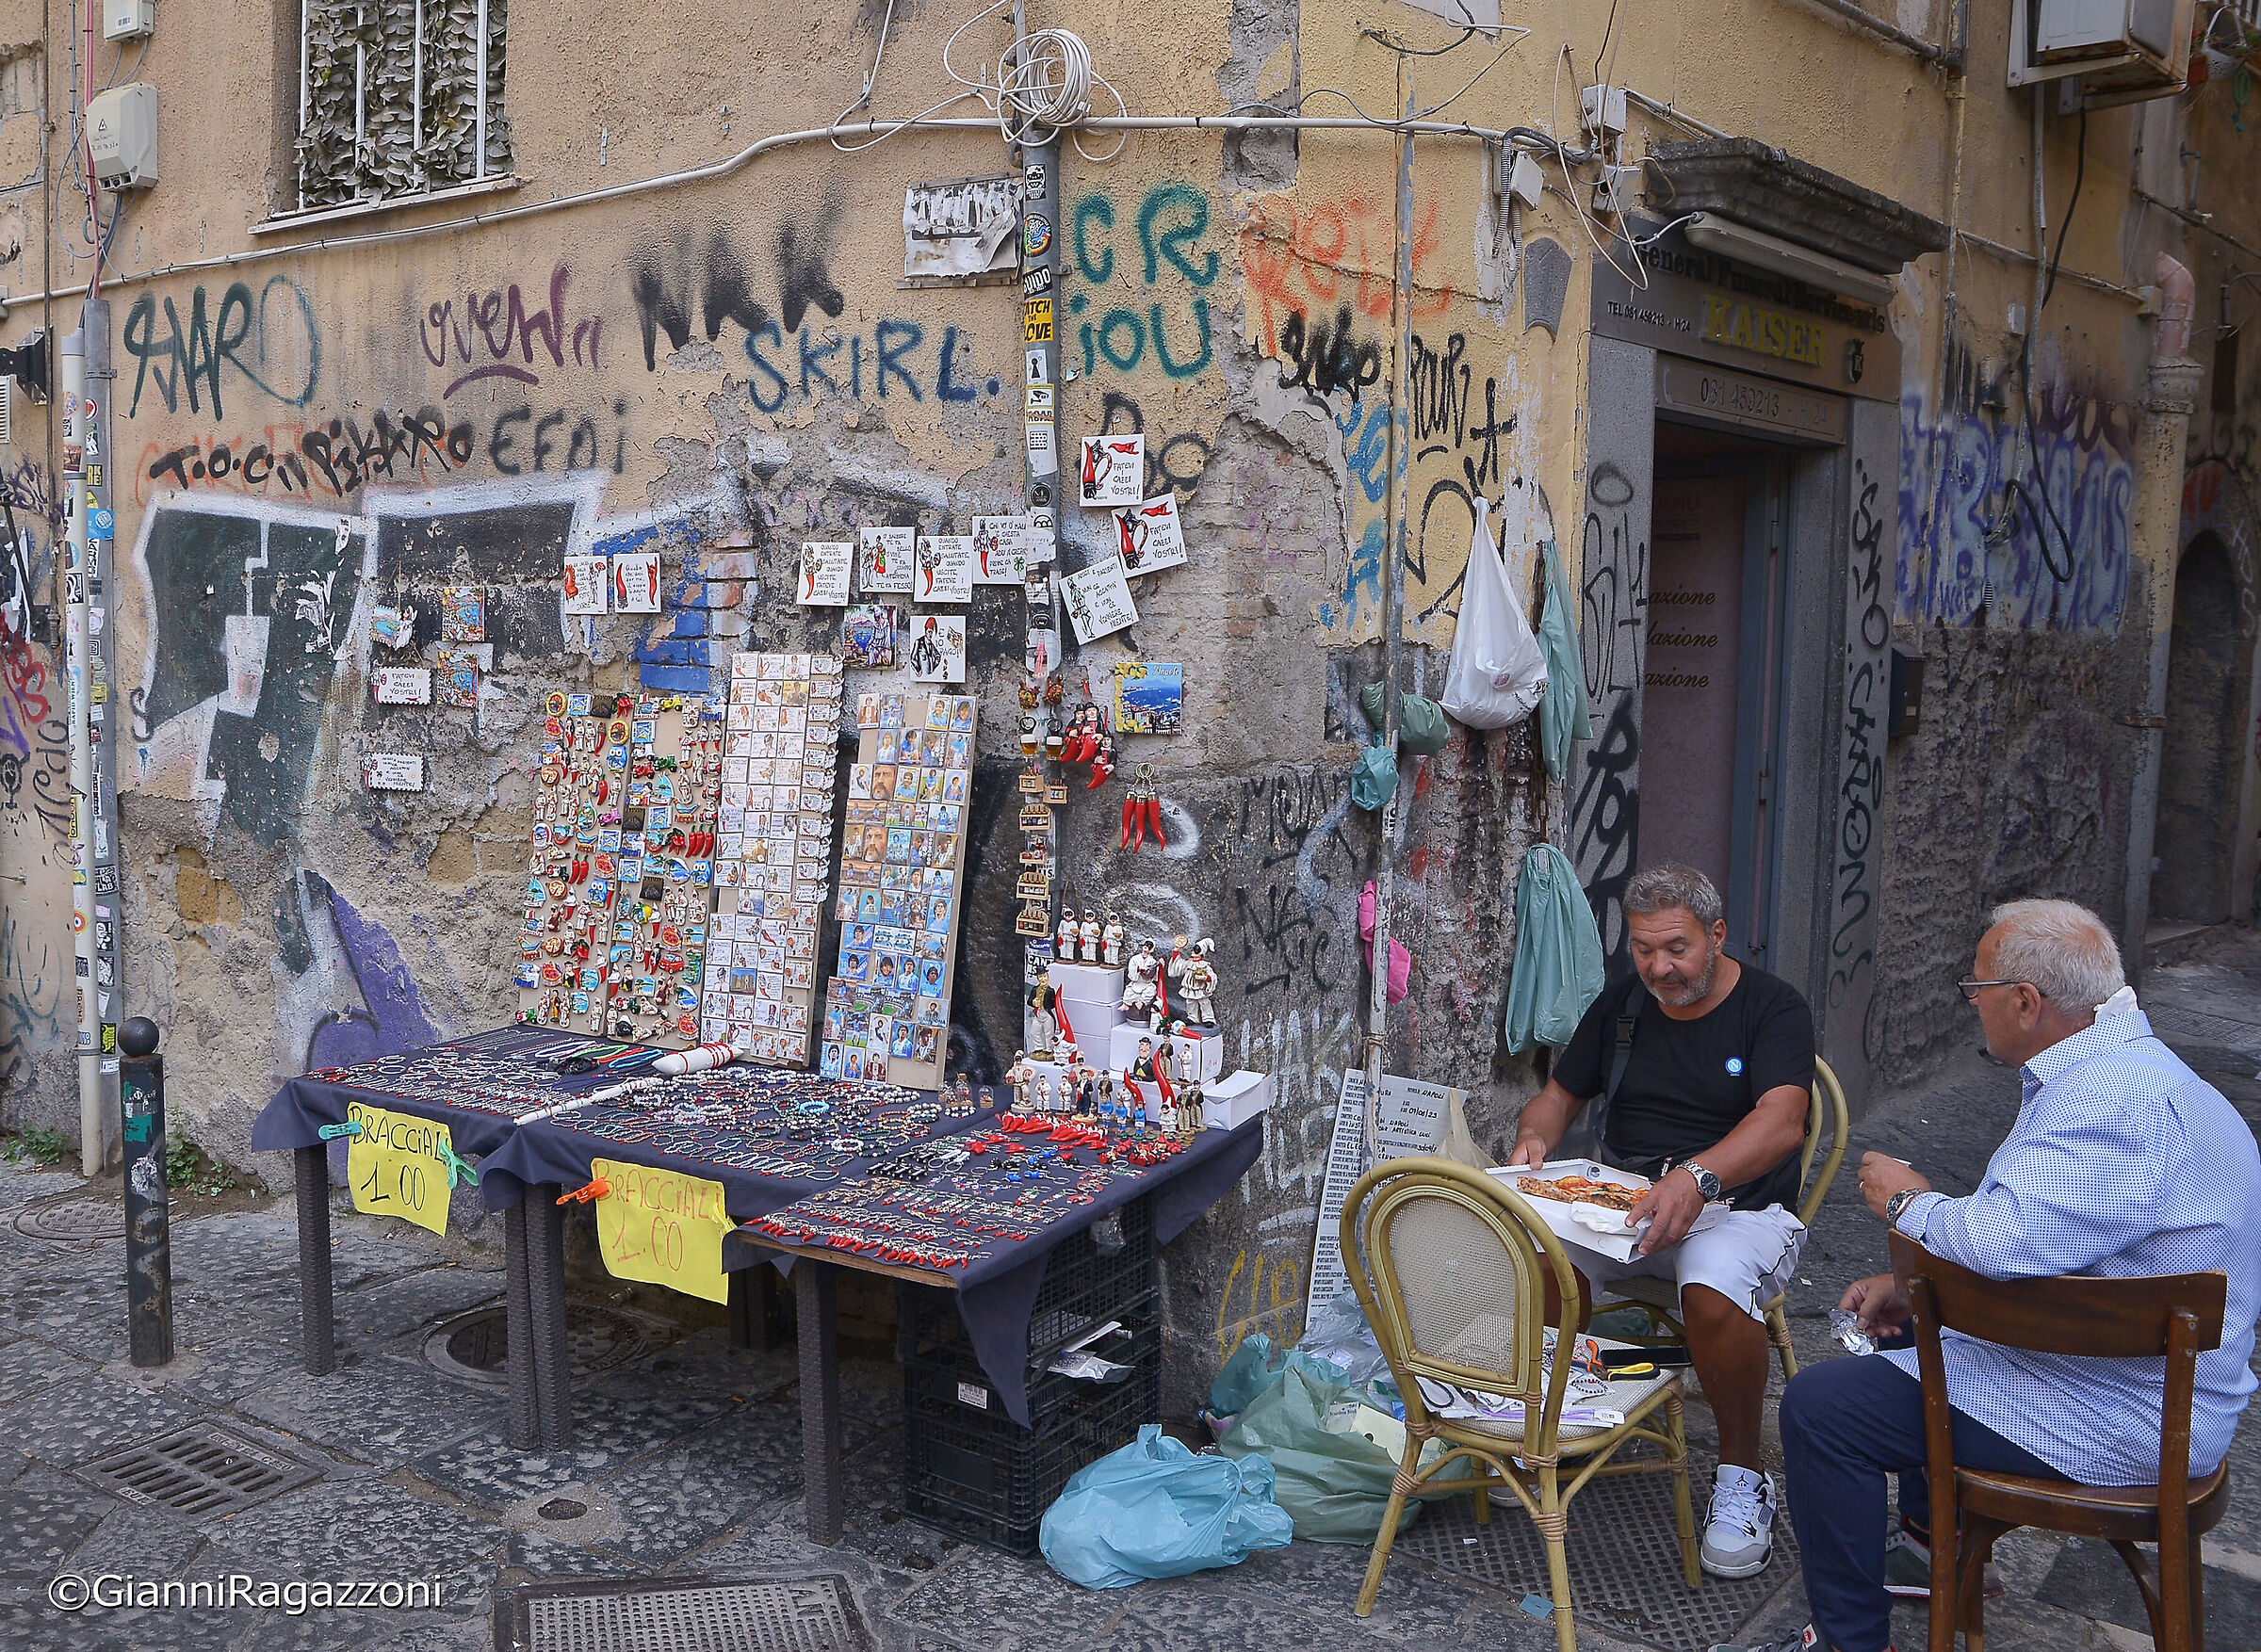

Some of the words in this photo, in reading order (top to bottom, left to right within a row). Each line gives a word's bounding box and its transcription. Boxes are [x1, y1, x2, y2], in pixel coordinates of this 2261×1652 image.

[1028, 313, 1037, 323] THE
[1607, 300, 1623, 317] TEL
[1624, 305, 1638, 321] 081
[1639, 310, 1666, 327] 459213
[1702, 295, 1827, 367] KAISER
[1700, 378, 1725, 405] 081
[1732, 384, 1780, 418] 459213
[1113, 462, 1134, 471] FATEVI
[1110, 484, 1140, 500] VOSTRI!
[1149, 522, 1171, 536] FATEVI
[1152, 543, 1184, 559] VOSTRI!
[389, 688, 421, 699] VOSTRI!
